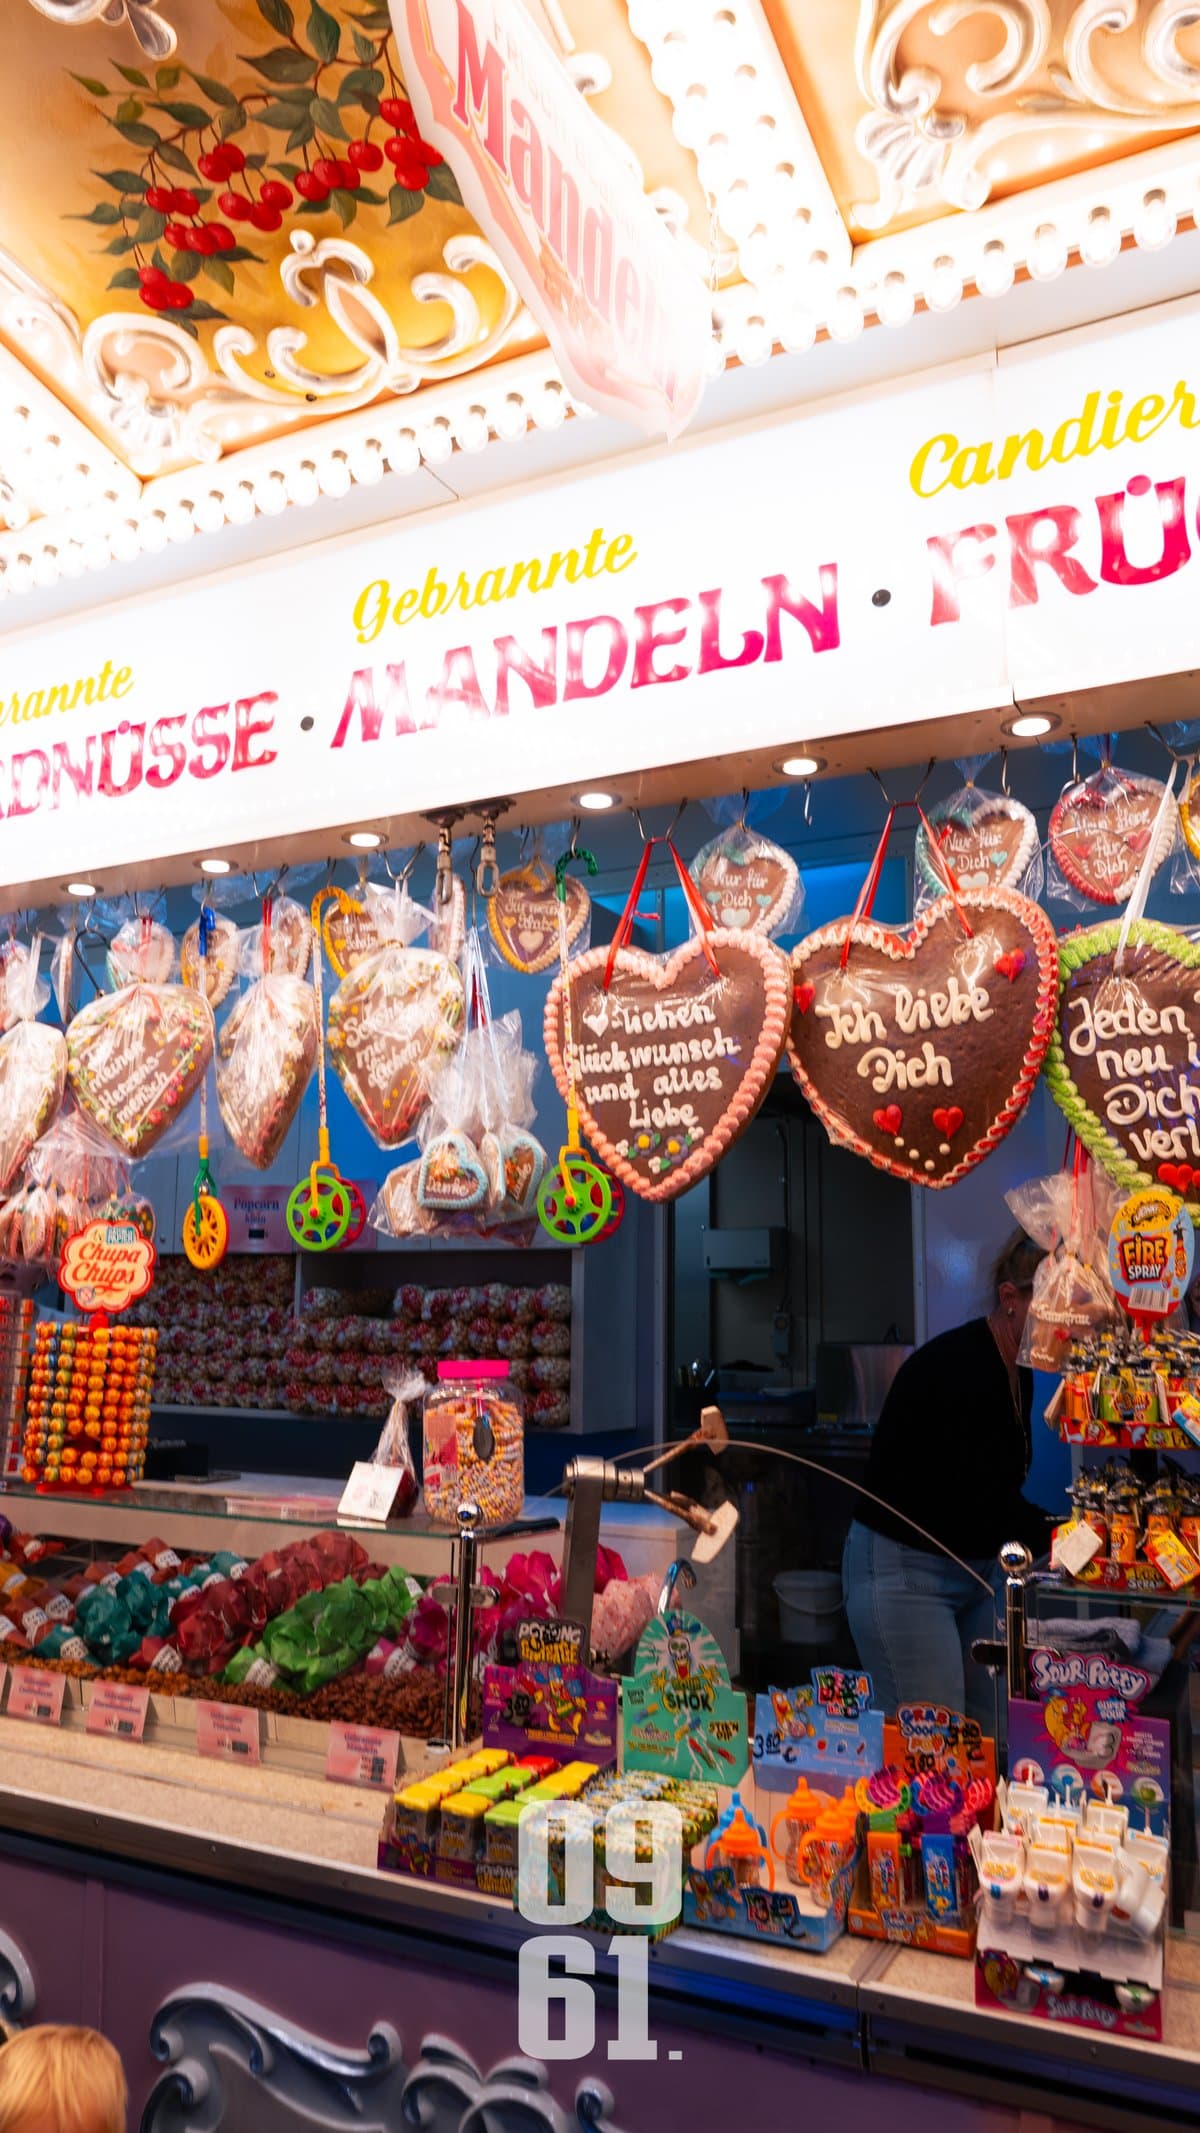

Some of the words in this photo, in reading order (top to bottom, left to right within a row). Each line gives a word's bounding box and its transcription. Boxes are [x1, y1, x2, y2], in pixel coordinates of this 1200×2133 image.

[926, 474, 1200, 627] FRÜ
[352, 528, 638, 645] Gebrannte
[330, 562, 841, 749] MANDELN
[0, 659, 134, 727] rannte
[0, 691, 279, 819] DNÜSSE
[956, 849, 990, 873] Dich
[721, 889, 753, 908] Dich
[814, 1000, 888, 1049] Ich
[894, 978, 994, 1035] liebe
[1068, 989, 1192, 1057] Jeden
[856, 1041, 953, 1094] Dich
[1096, 1044, 1174, 1081] neu
[584, 1071, 641, 1106] und
[653, 1066, 723, 1096] alles
[1104, 1074, 1200, 1126] Dich
[629, 1098, 700, 1130] Liebe
[78, 1241, 142, 1266] Chupa
[1122, 1233, 1166, 1267] FIRE
[1127, 1264, 1161, 1281] SPRAY
[71, 1262, 136, 1292] Chups
